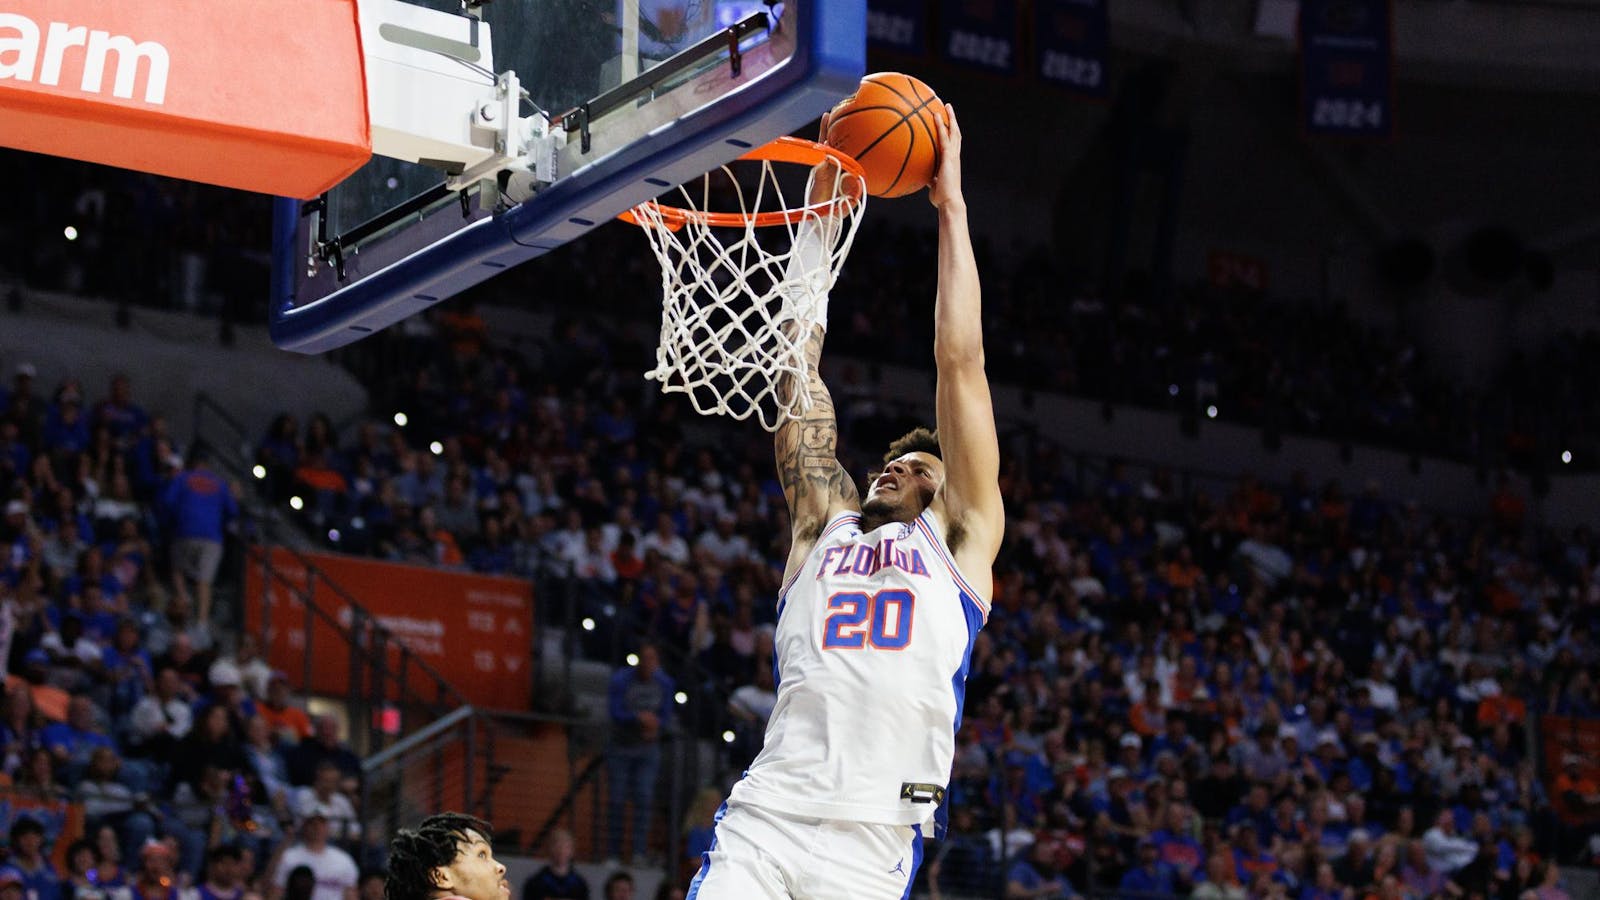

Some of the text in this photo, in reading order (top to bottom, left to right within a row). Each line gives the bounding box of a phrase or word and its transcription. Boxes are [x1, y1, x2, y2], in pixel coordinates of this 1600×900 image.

[1313, 98, 1382, 127] 2024
[816, 538, 931, 581] FLORIDA
[822, 588, 915, 651] 20
